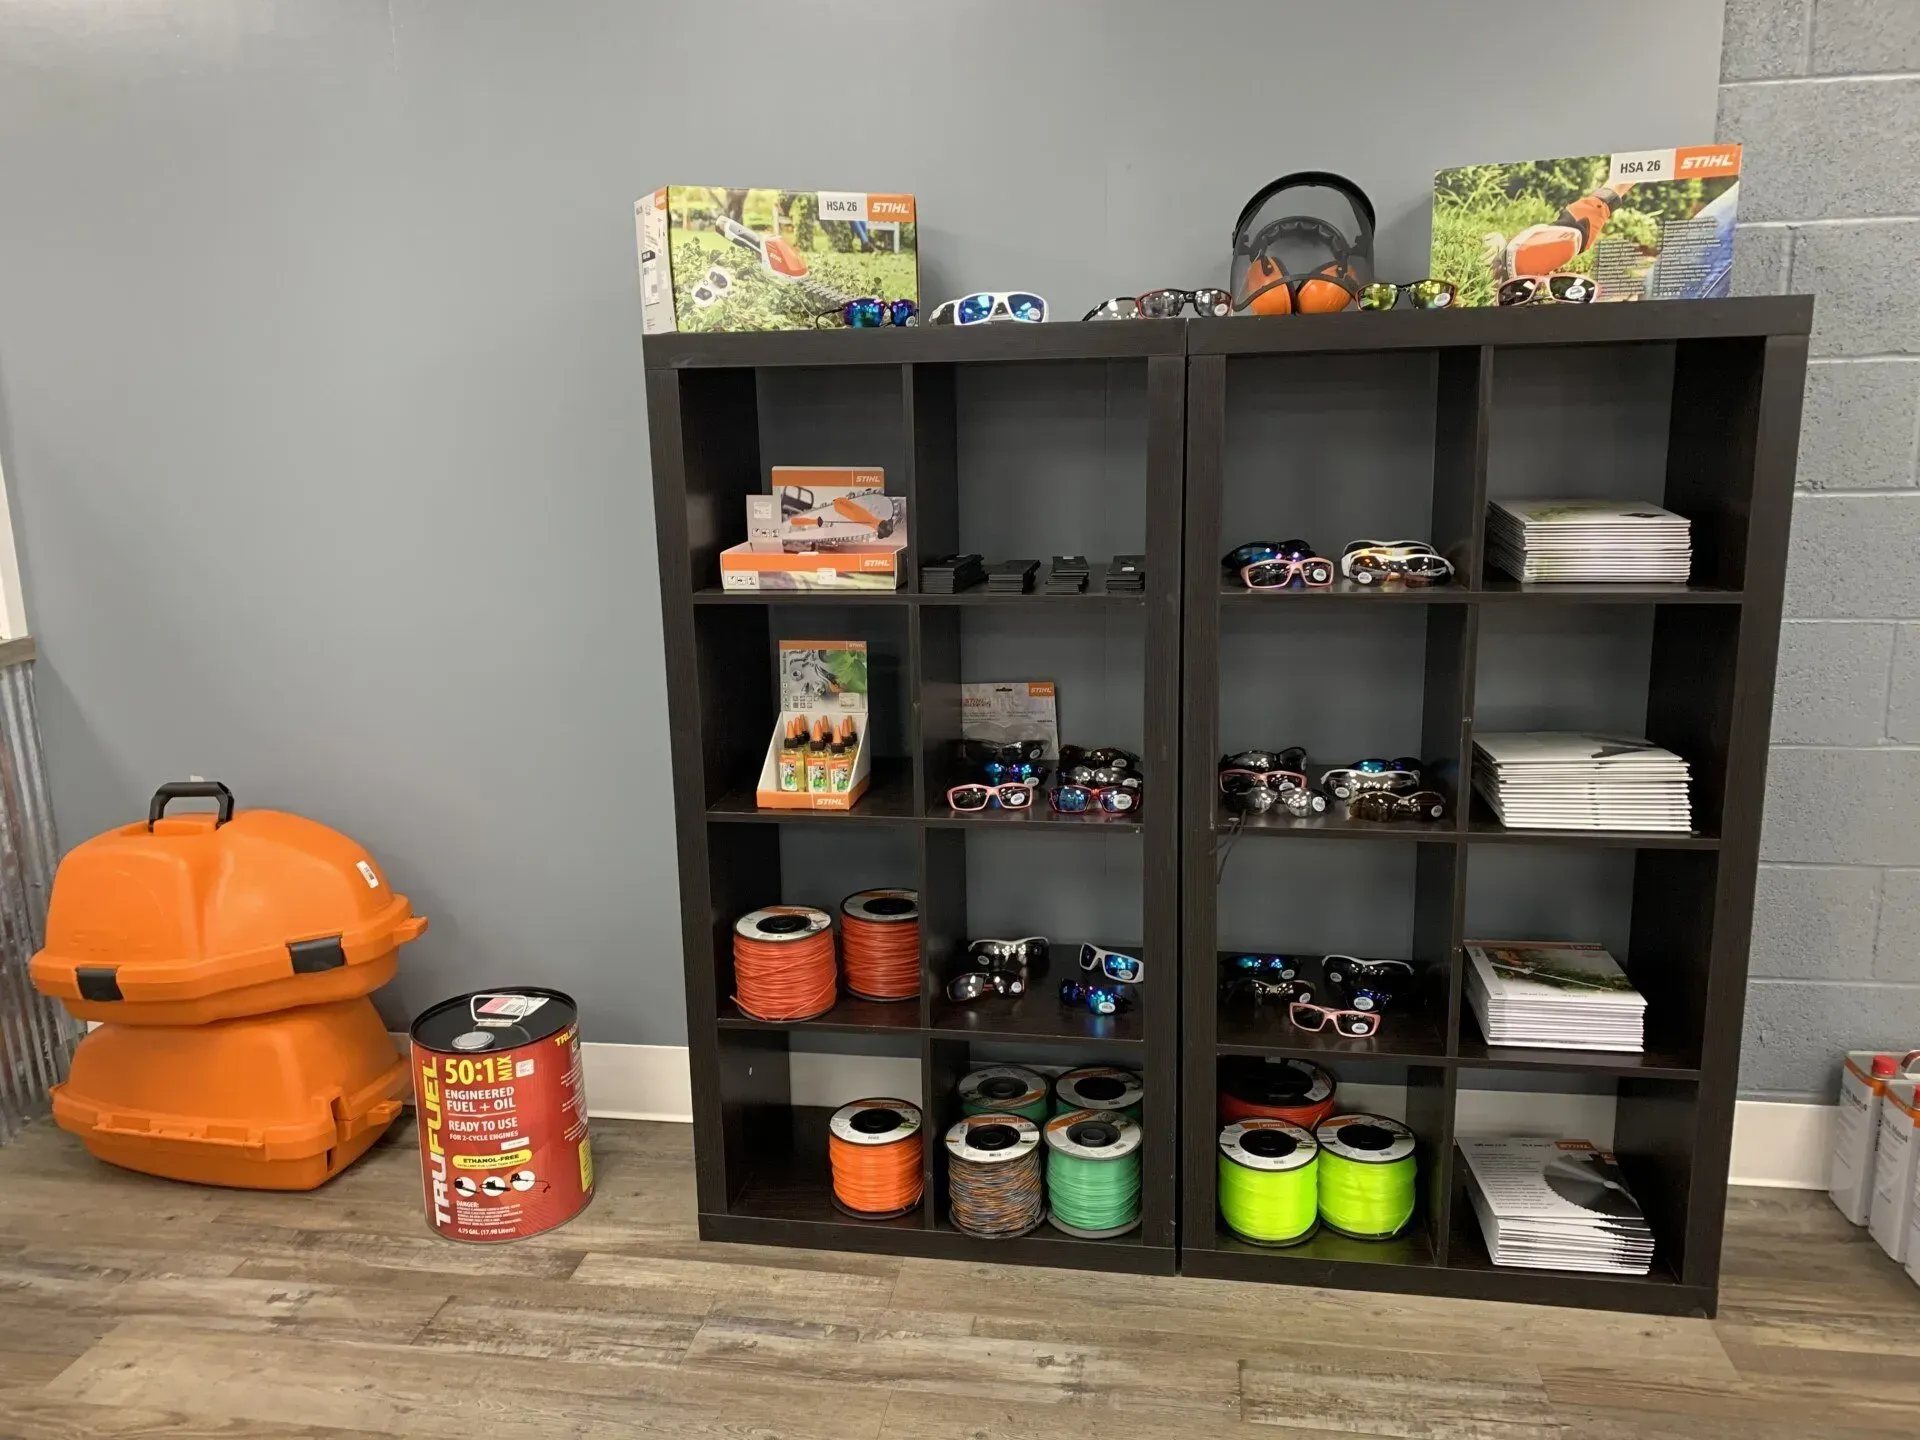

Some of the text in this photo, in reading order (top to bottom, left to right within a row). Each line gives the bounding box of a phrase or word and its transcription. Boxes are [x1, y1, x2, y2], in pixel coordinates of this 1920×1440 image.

[1619, 160, 1661, 174] HSA 26
[1679, 154, 1734, 170] STIHL
[826, 200, 858, 212] HSA 26
[871, 202, 911, 214] STIHL
[855, 475, 881, 483] STIHL
[863, 559, 890, 567] STIHL
[816, 798, 845, 806] STIHL
[445, 1057, 495, 1085] 50:1
[496, 1054, 514, 1082] MIX
[444, 1086, 515, 1100] ENGINEERED
[446, 1100, 477, 1113] FUEL
[493, 1097, 516, 1111] OIL
[448, 1117, 518, 1132] READY TO USE
[422, 1056, 452, 1227] TRUFUEL
[449, 1133, 462, 1141] FOR
[489, 1130, 519, 1140] ENGINES
[463, 1153, 520, 1164] ETHANOL-FREE
